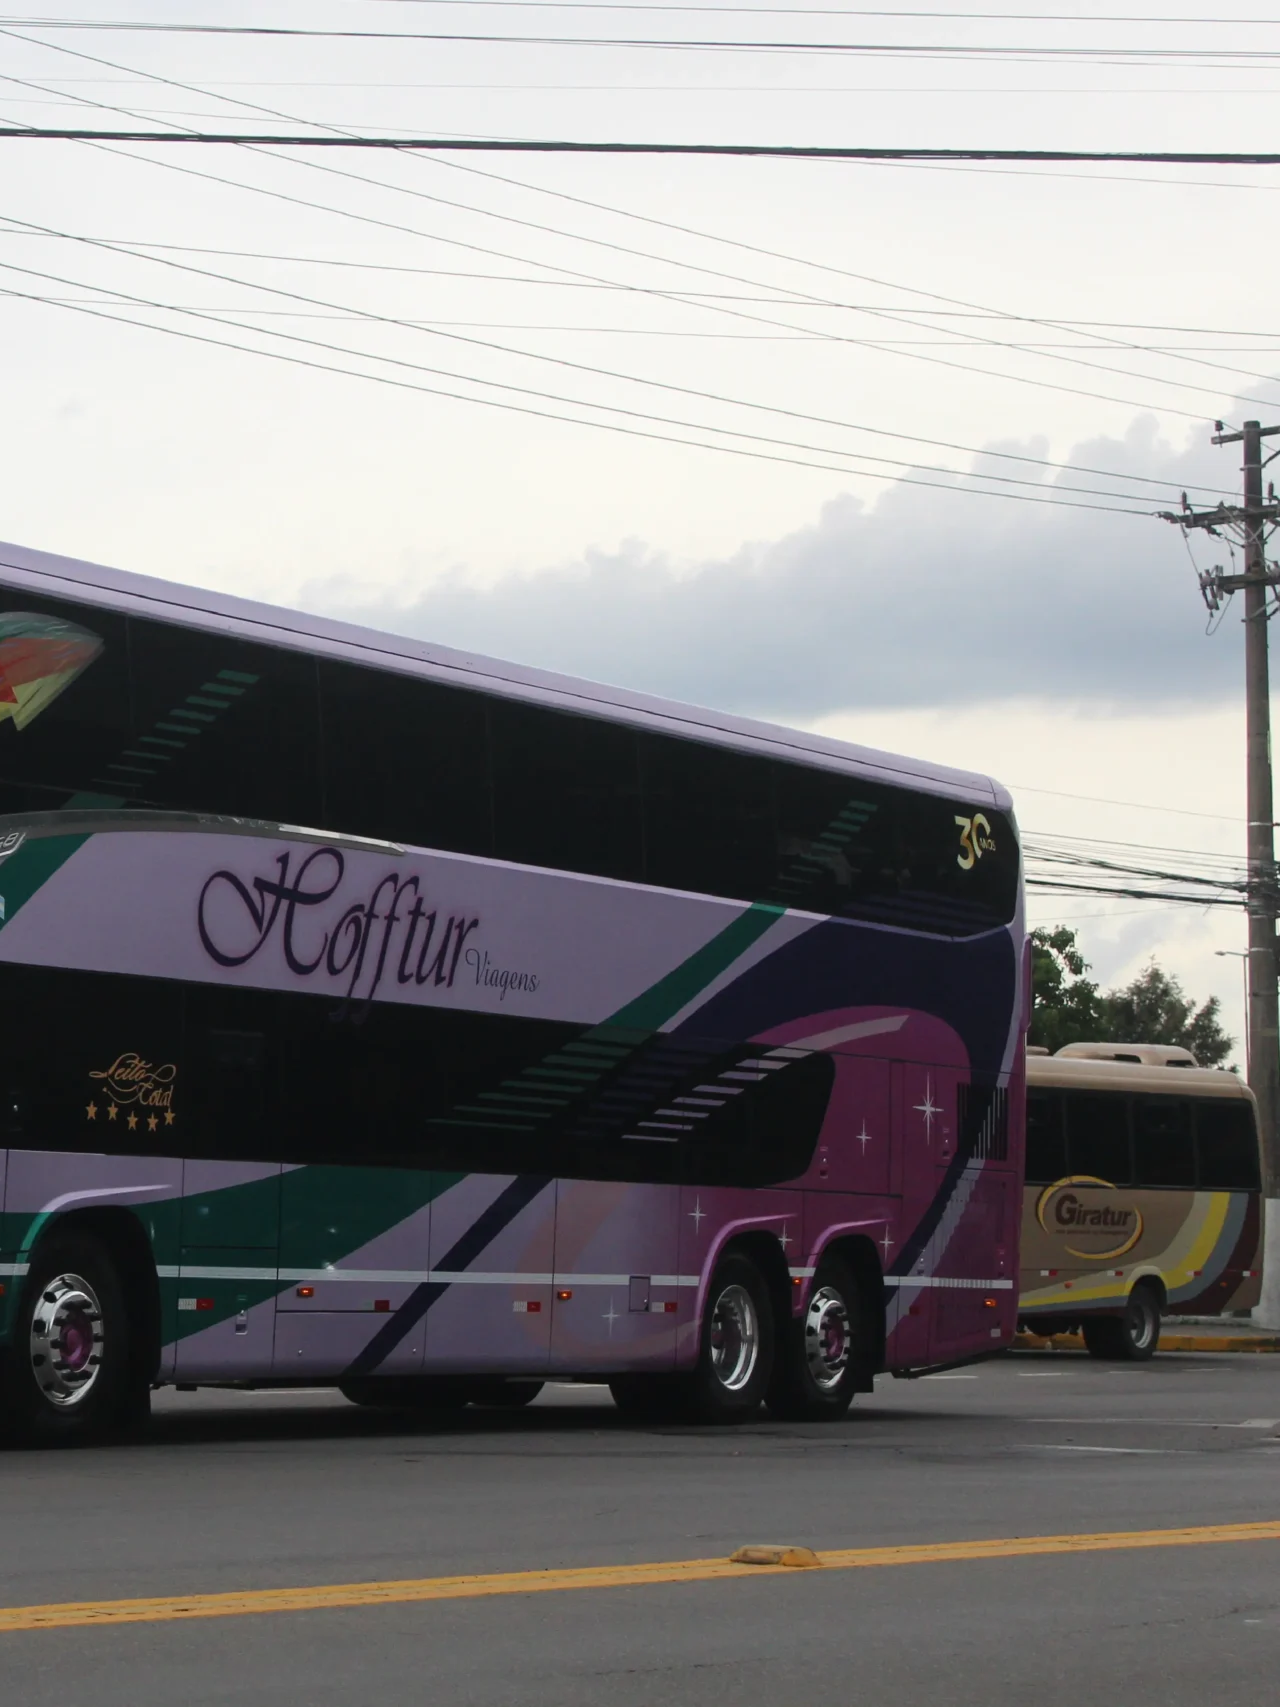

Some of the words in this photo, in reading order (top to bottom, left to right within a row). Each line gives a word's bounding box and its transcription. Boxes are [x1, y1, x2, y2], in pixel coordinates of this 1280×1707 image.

[954, 813, 991, 870] 30
[198, 847, 479, 1012] Hofftur
[465, 948, 541, 1001] Viagens
[1055, 1194, 1132, 1226] Giratur
